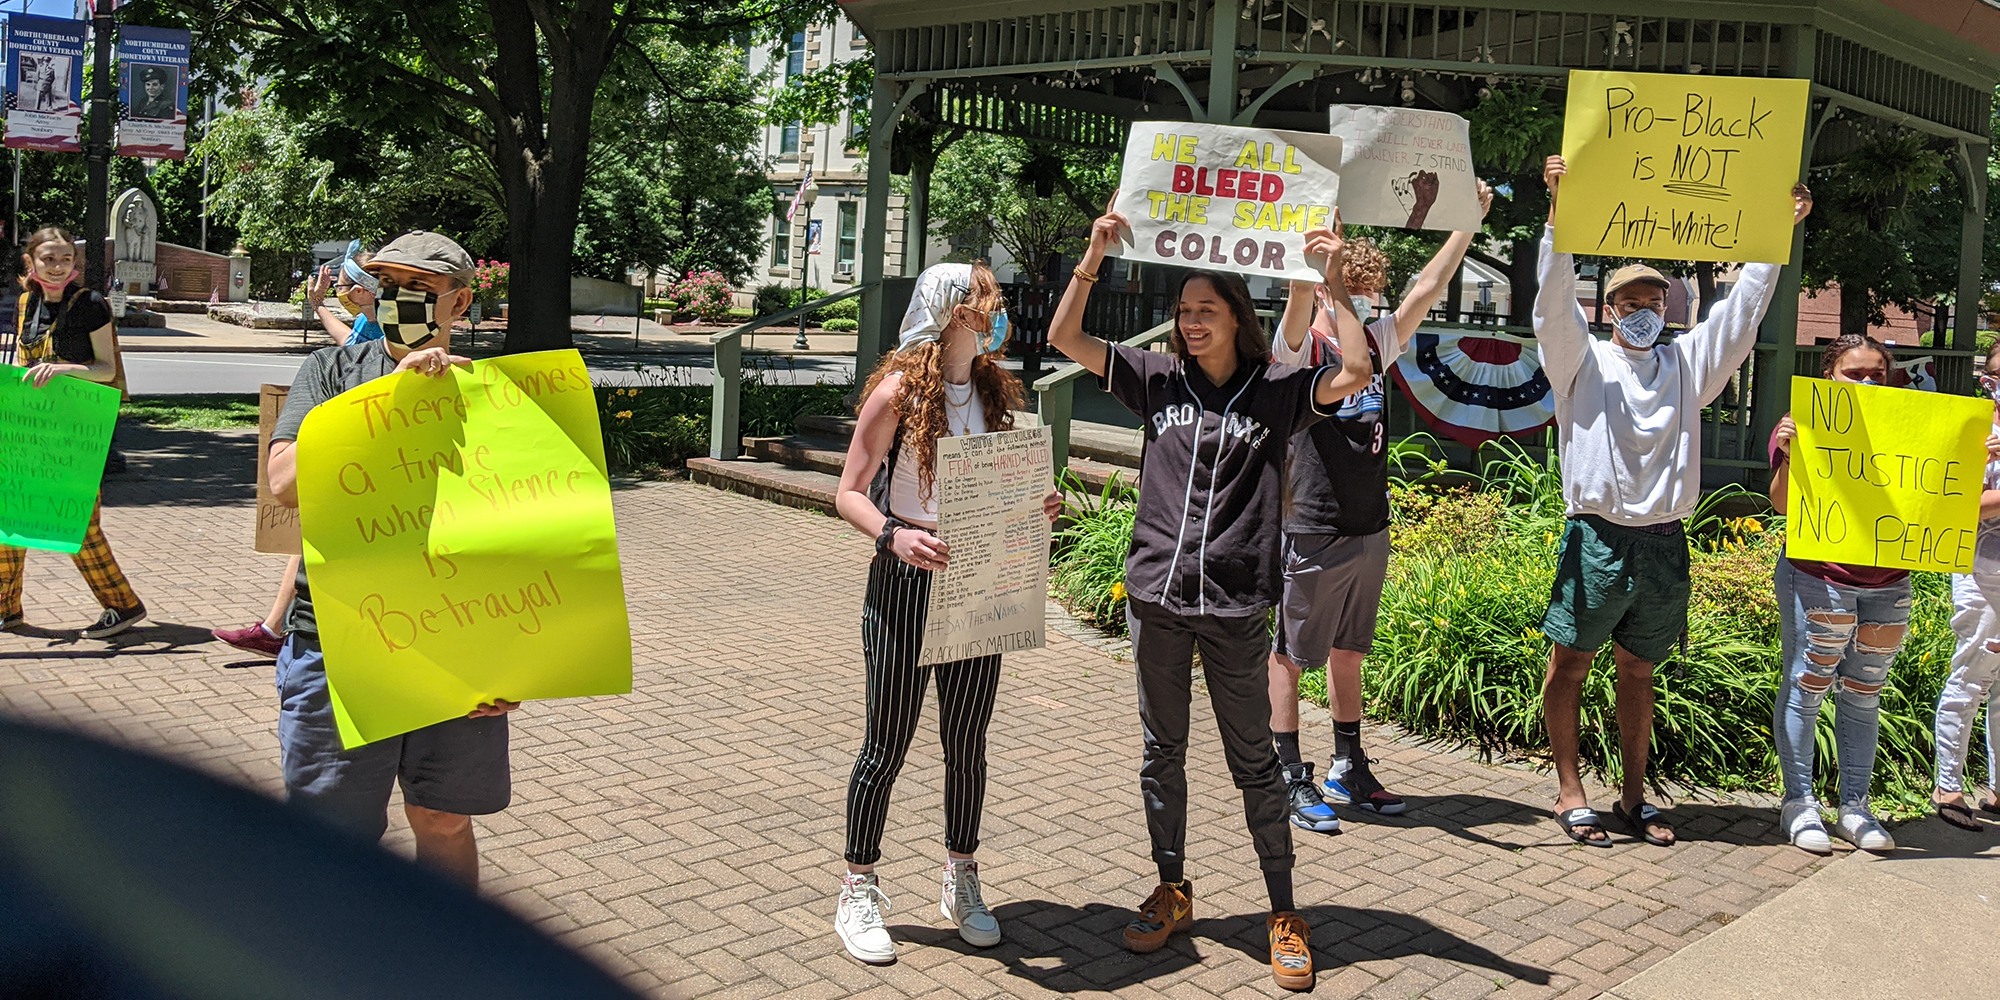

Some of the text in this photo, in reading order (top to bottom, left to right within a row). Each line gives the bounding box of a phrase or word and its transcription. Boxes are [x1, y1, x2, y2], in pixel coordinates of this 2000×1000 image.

[9, 41, 83, 56] HOMETOWN VETERANS
[14, 29, 80, 43] NORTHUMBERLAND
[32, 38, 60, 47] COUNTY
[124, 39, 186, 50] NORTHUMBERLAND
[142, 47, 168, 56] COUNTY
[118, 51, 189, 64] HOMETOWN VETERANS
[1375, 110, 1453, 131] UNDERSTAND
[1606, 87, 1773, 140] Pro-Black
[1150, 132, 1302, 175] WE ALL
[1376, 131, 1408, 146] WILL
[1412, 136, 1443, 150] NEVER
[1413, 152, 1424, 167] I
[1429, 154, 1467, 172] STAND
[1632, 144, 1740, 190] is NOT
[1171, 164, 1285, 203] BLEED
[1146, 191, 1330, 234] THE SAME
[1596, 201, 1742, 251] Anti-White!
[1154, 229, 1286, 271] COLOR
[350, 391, 471, 439] There
[1811, 382, 1853, 435] NO
[960, 435, 992, 451] WHITE
[972, 449, 983, 457] can
[1007, 443, 1028, 453] following
[1371, 421, 1385, 455] 3
[391, 444, 494, 484] time
[948, 458, 973, 476] FEAR
[981, 461, 993, 470] being
[1026, 449, 1049, 466] KILLED
[1815, 446, 1963, 497] JUSTICE
[355, 499, 457, 544] when
[1798, 495, 1974, 568] NO PEACE
[418, 542, 459, 579] is
[359, 570, 563, 653] Betrayal
[922, 630, 1037, 664] BLACK LIVES MATTER!
